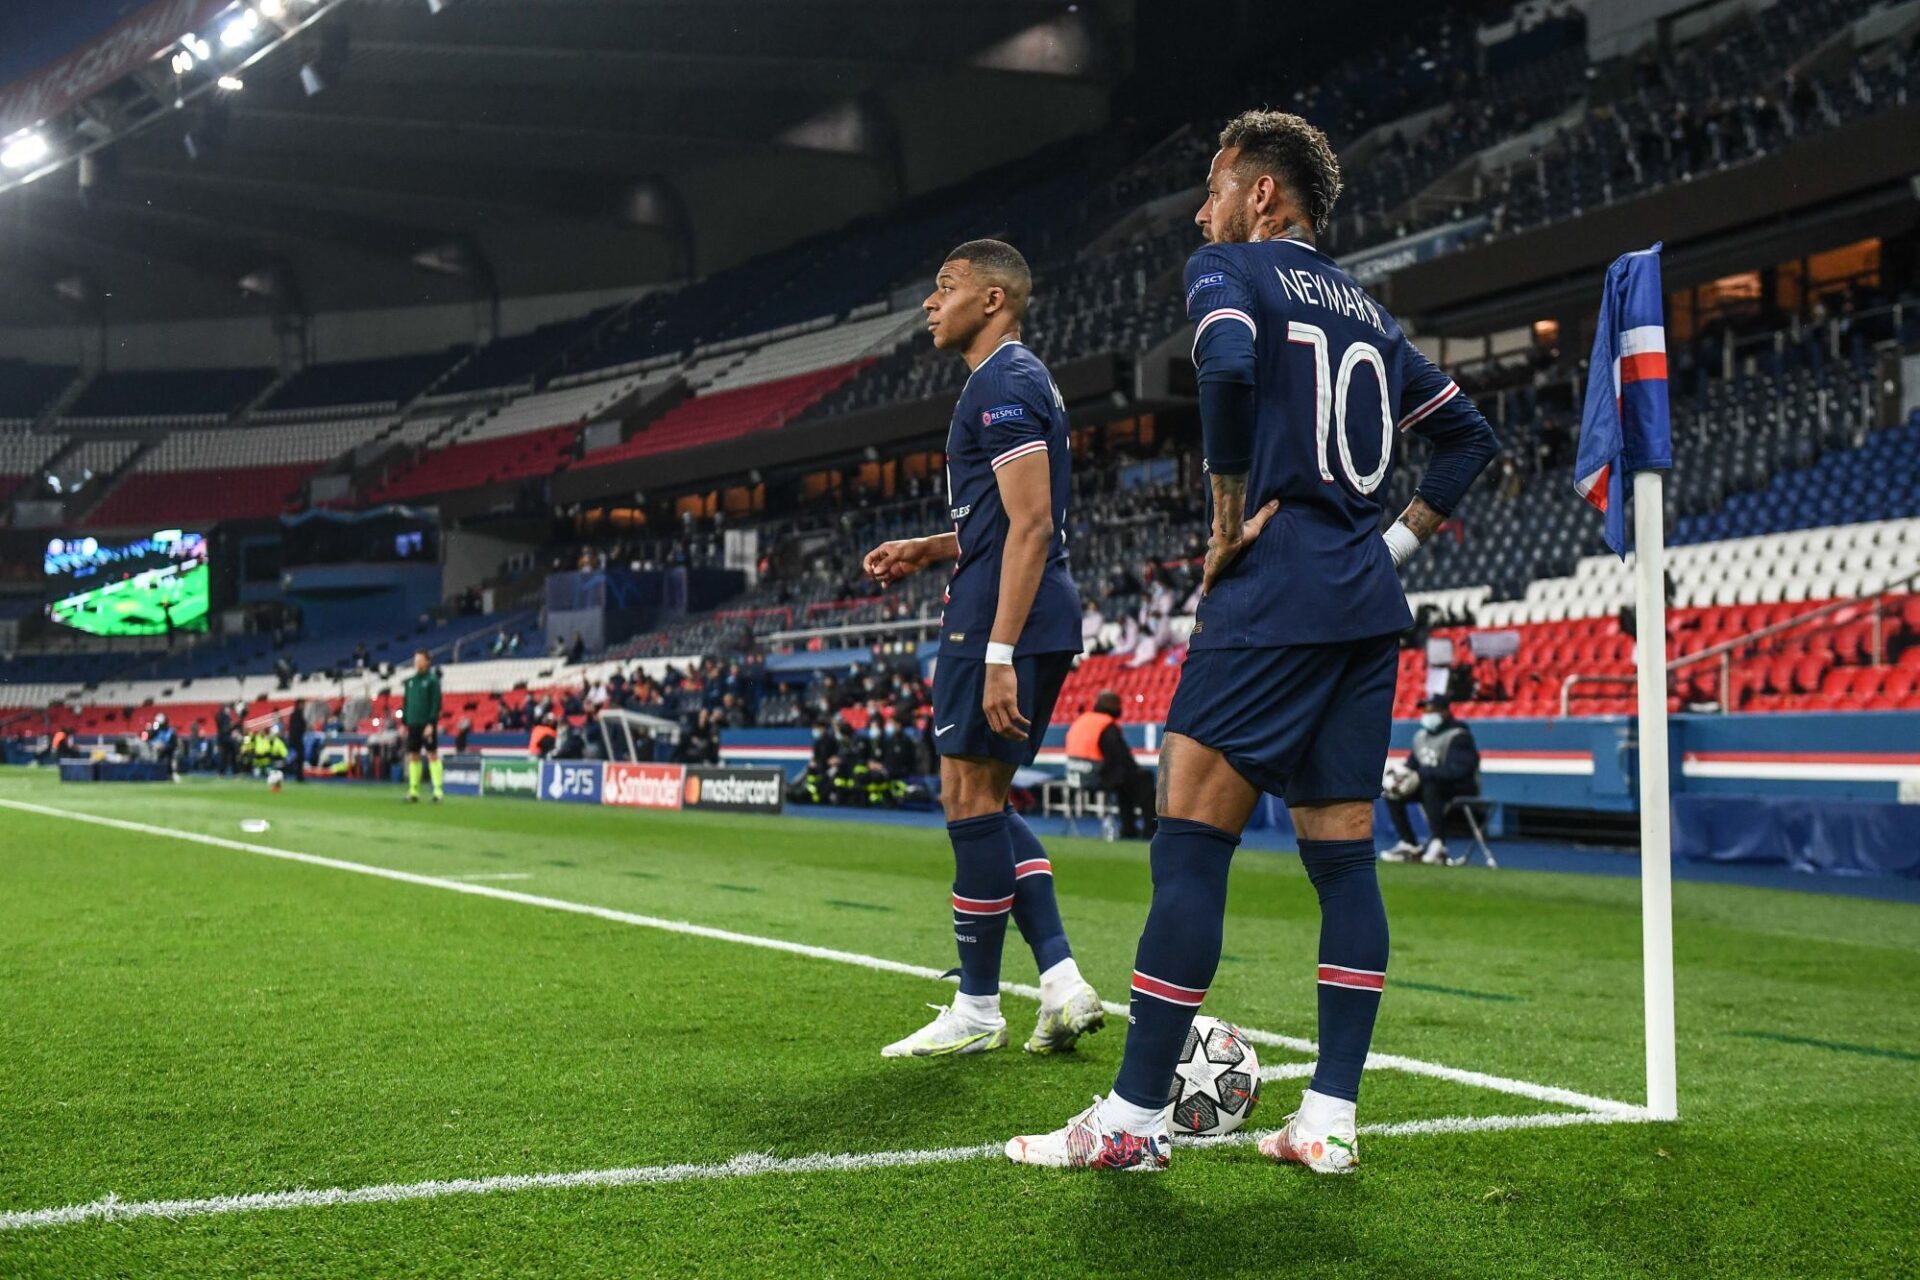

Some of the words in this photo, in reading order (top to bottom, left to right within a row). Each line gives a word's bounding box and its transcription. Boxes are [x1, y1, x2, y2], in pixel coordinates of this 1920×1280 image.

[1188, 275, 1224, 300] RESPECT
[1274, 265, 1371, 324] NEYMAR
[991, 408, 1023, 420] RESPECT
[1286, 320, 1394, 495] 10
[564, 767, 595, 796] PS5
[618, 768, 681, 806] Santander
[701, 773, 780, 805] mastercard
